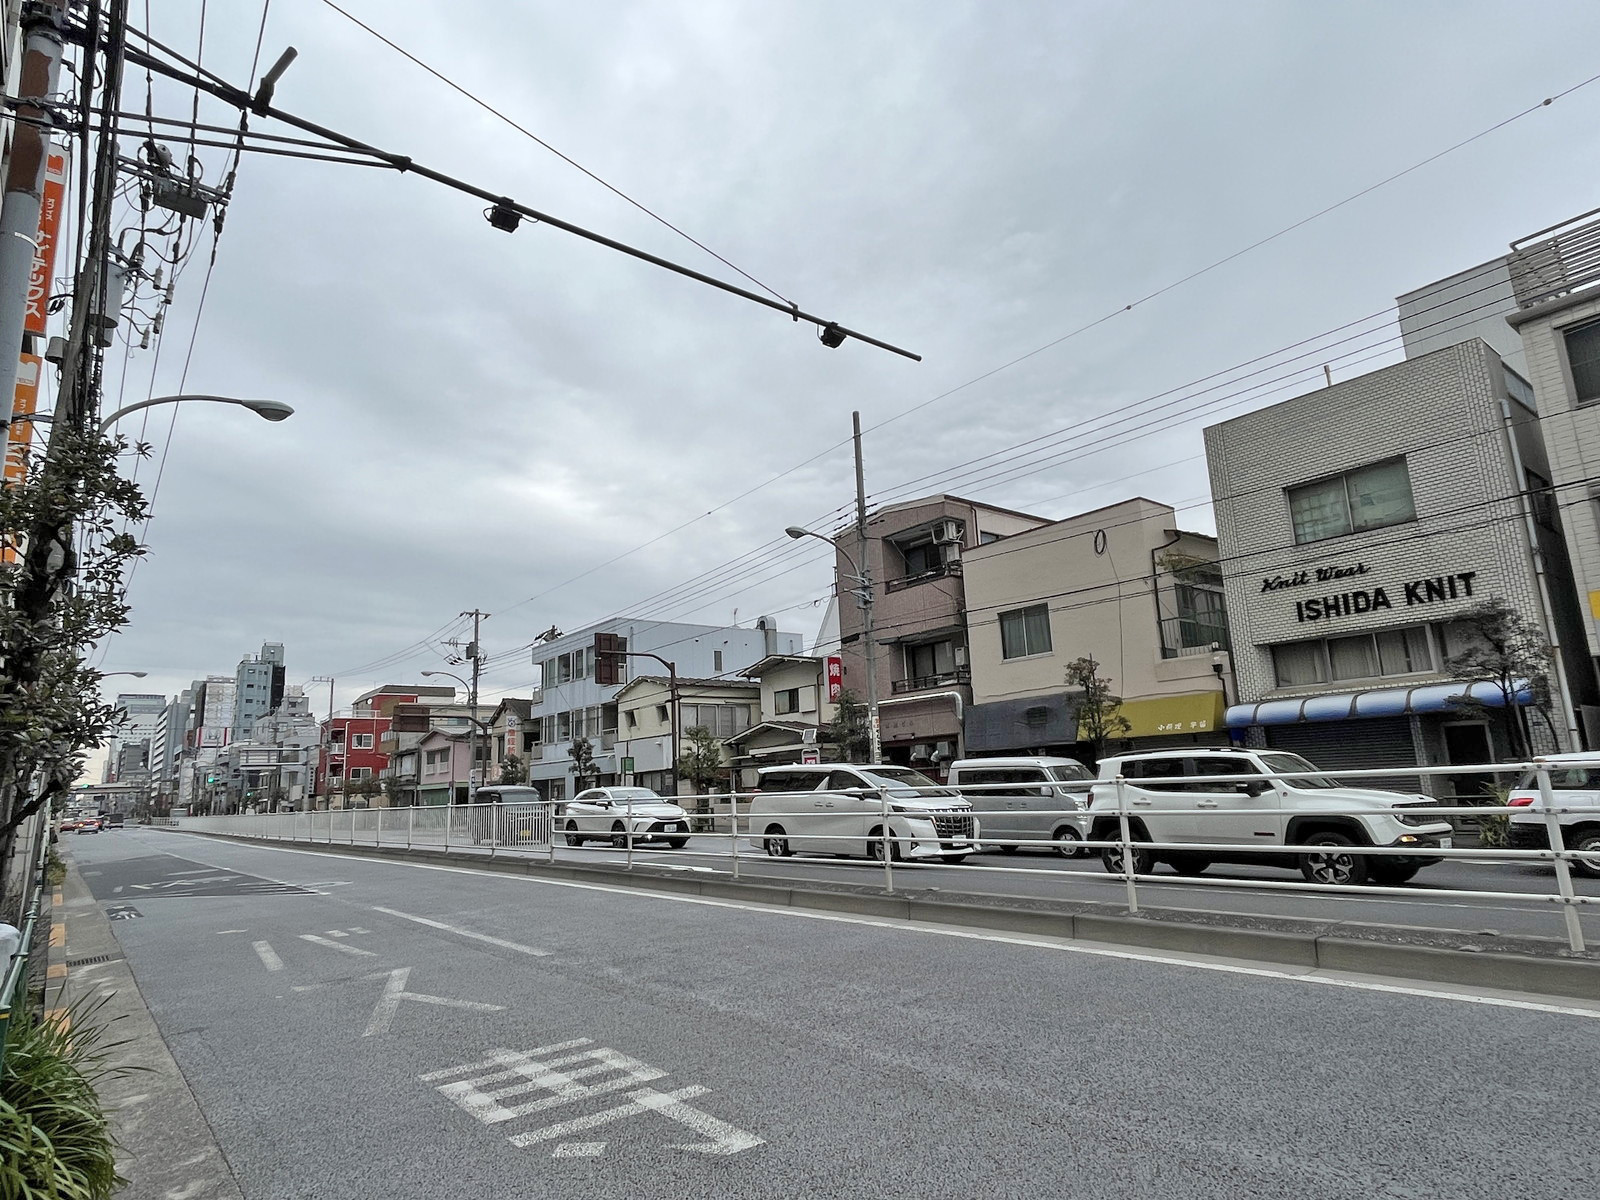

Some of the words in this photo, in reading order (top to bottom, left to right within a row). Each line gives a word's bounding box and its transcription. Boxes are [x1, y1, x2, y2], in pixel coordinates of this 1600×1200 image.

[1261, 570, 1310, 592] Knit
[1315, 563, 1371, 582] Wear
[1296, 587, 1392, 623] ISHIDA
[1404, 571, 1476, 606] KNIT
